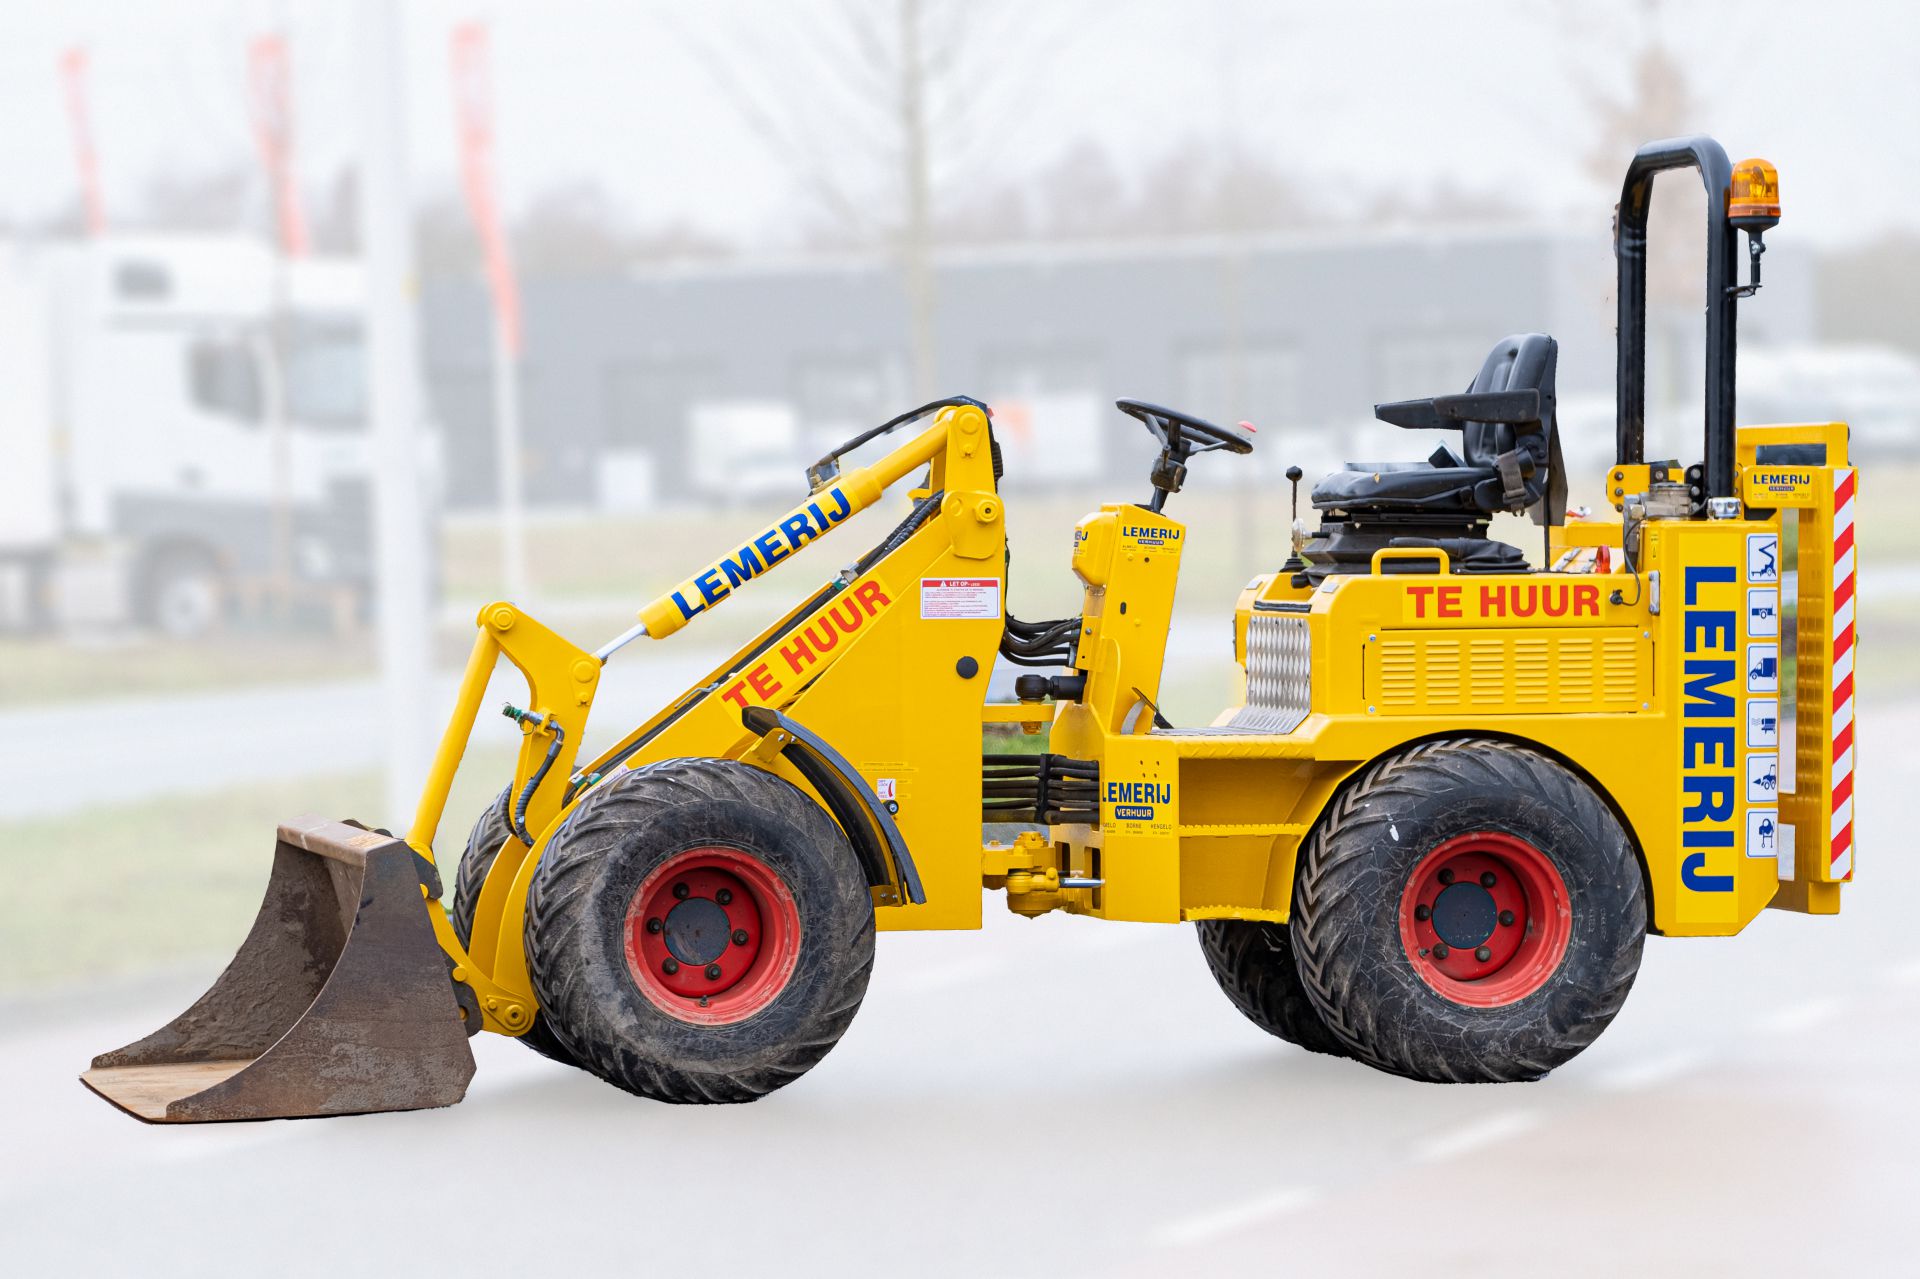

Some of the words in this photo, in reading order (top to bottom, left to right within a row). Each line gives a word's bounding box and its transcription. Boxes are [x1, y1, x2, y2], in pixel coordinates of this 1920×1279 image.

[1753, 474, 1810, 485] LEMERIJ
[1122, 526, 1180, 540] LEMERIJ
[671, 487, 851, 620] LEMERIJ
[1407, 586, 1463, 618] TE
[1480, 585, 1600, 618] HUUR
[722, 662, 783, 708] TE
[780, 580, 892, 675] HUUR
[1681, 566, 1737, 893] LEMERIJ
[1116, 808, 1152, 817] VERHUUR
